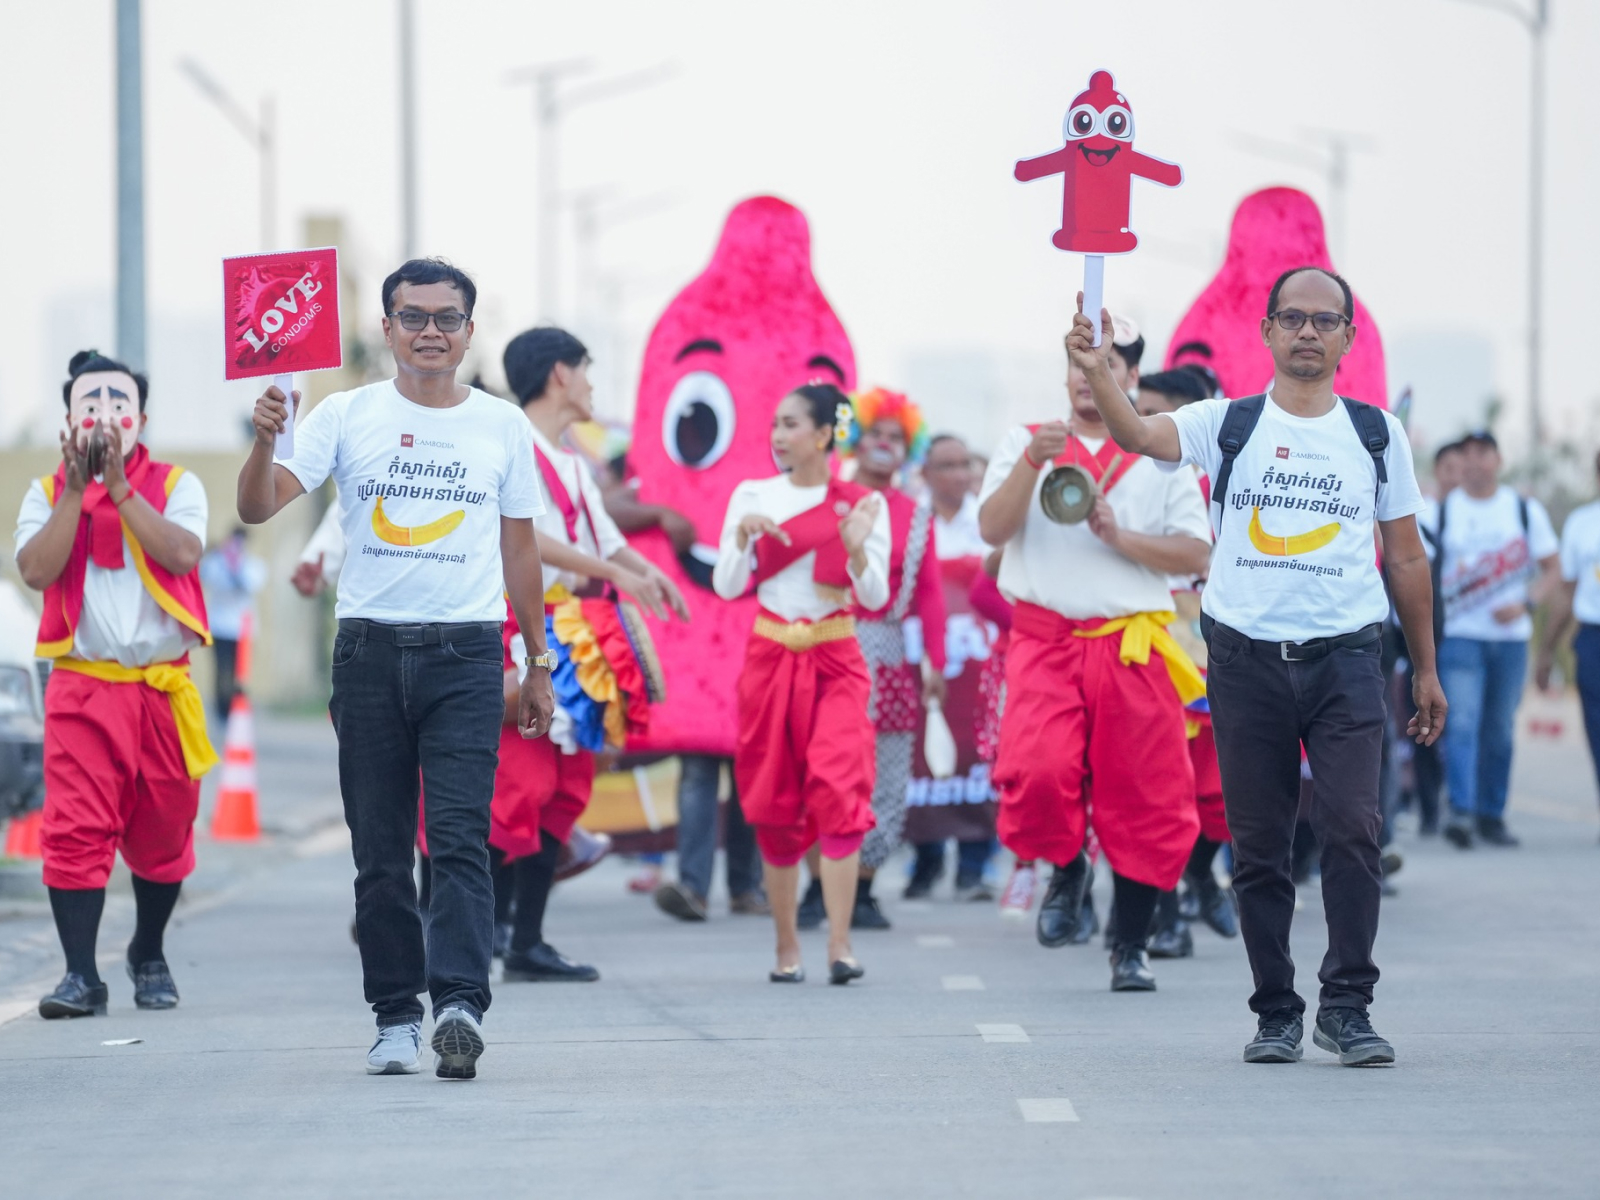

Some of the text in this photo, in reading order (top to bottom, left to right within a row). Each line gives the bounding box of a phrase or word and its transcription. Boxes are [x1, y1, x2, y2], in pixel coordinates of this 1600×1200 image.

[242, 272, 323, 353] LOVE
[271, 302, 323, 353] CONDOMS
[414, 438, 455, 449] CAMBODIA
[1290, 451, 1331, 462] CAMBODIA
